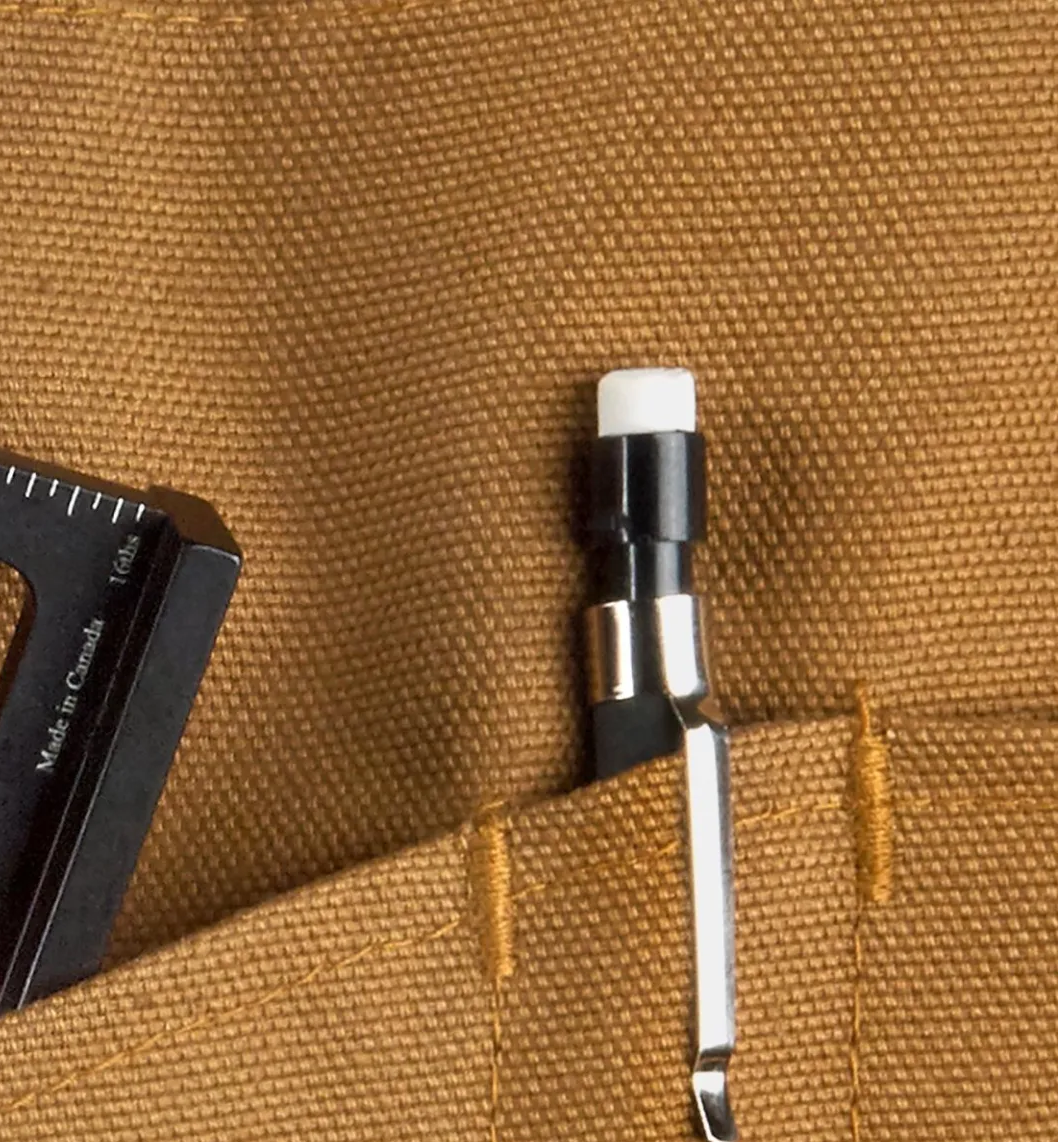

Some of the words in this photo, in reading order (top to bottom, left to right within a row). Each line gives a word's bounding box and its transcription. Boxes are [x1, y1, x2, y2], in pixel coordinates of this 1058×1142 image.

[110, 534, 139, 585] 16ths
[66, 618, 105, 691] Canada
[55, 695, 78, 714] in
[35, 718, 70, 774] Made
